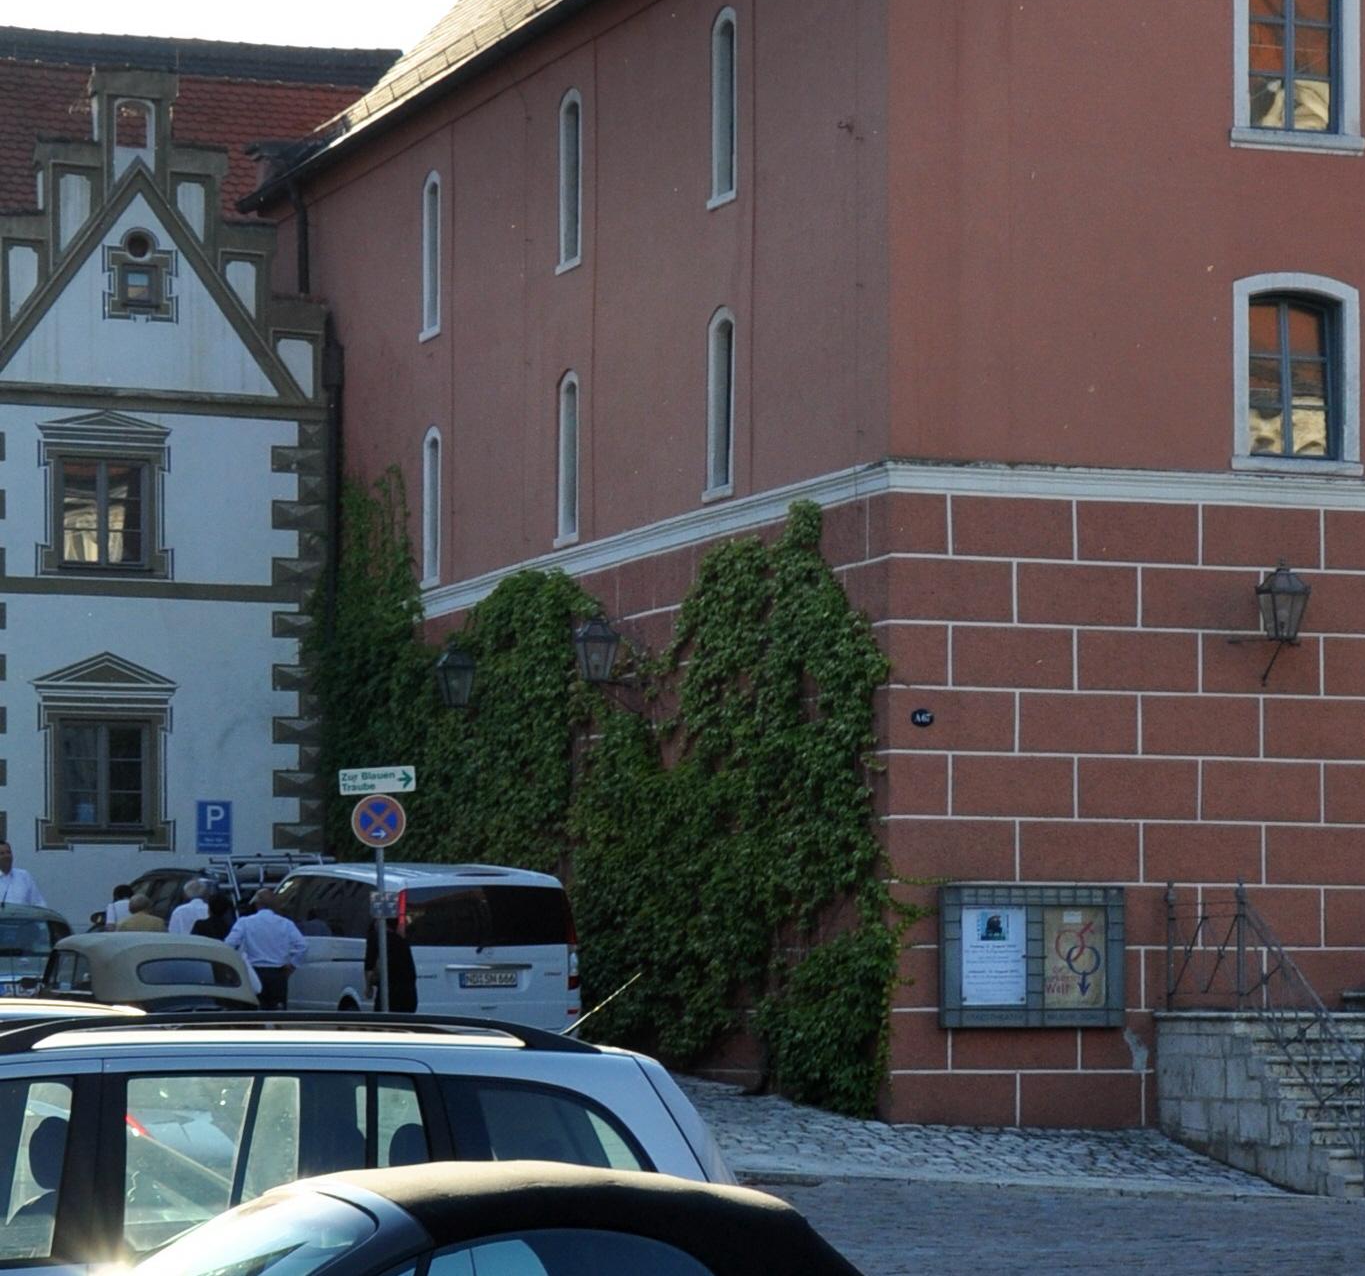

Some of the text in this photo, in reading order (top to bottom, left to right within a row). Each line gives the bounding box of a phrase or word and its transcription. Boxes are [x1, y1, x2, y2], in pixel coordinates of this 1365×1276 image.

[341, 771, 396, 782] Zur Blauen
[341, 783, 376, 792] Traube
[206, 805, 225, 830] P
